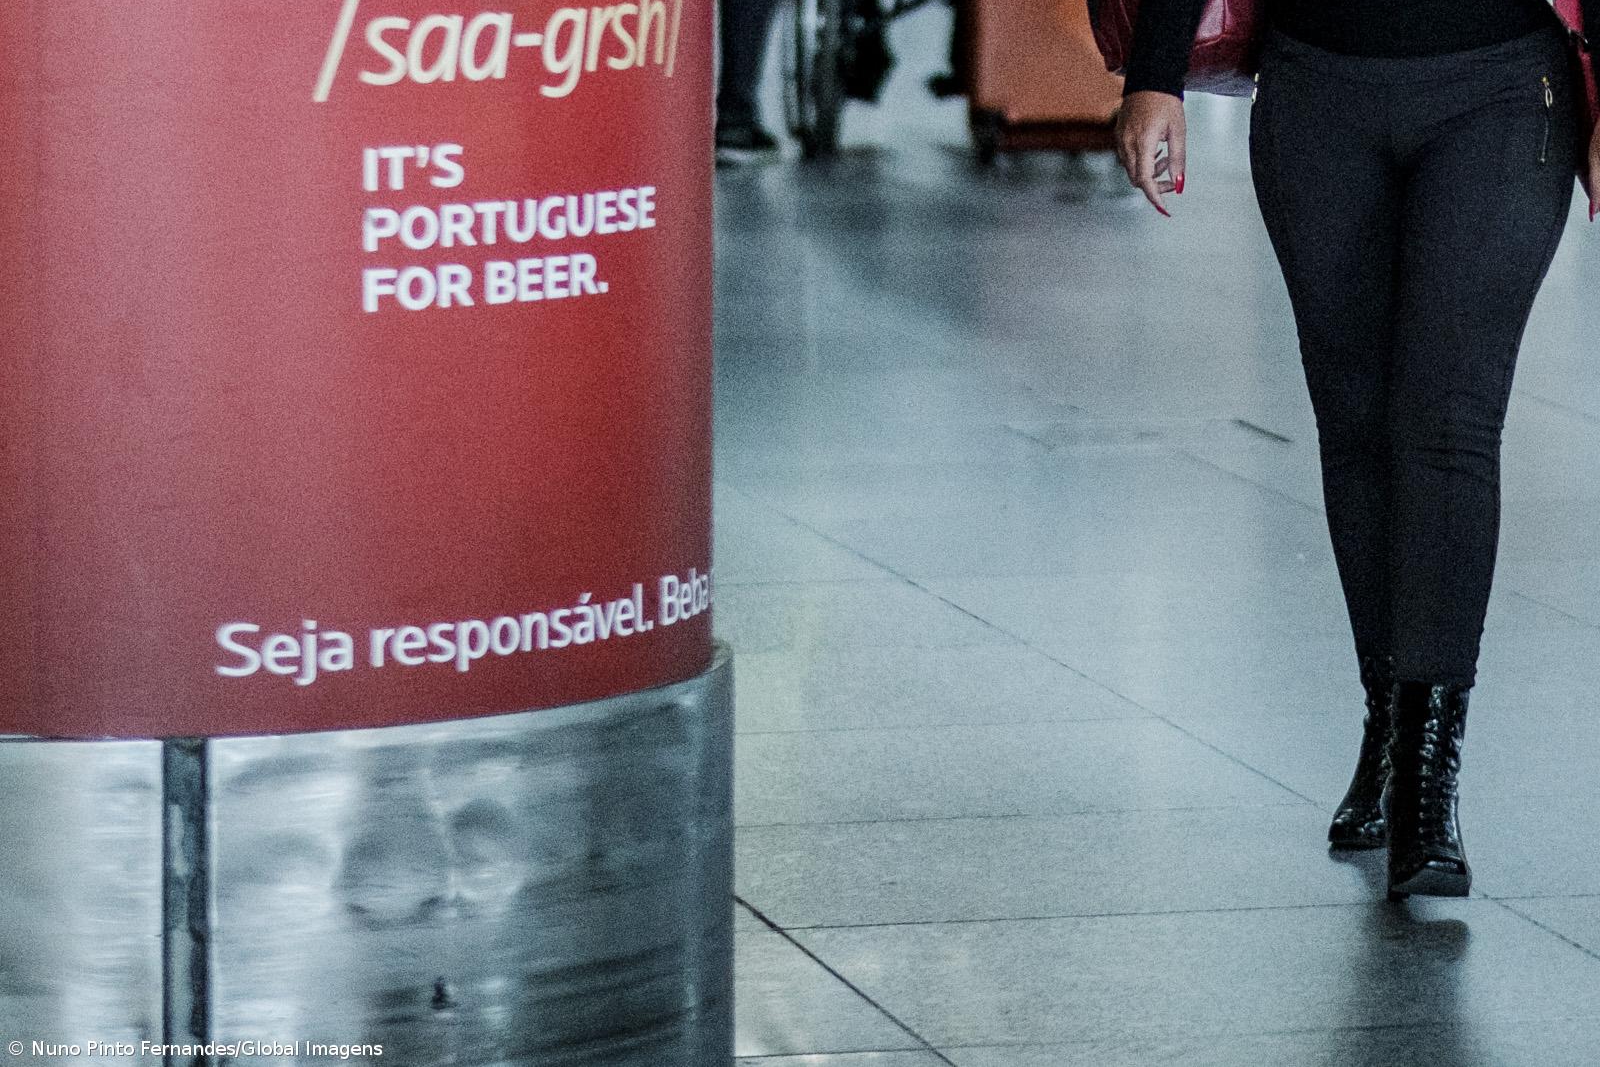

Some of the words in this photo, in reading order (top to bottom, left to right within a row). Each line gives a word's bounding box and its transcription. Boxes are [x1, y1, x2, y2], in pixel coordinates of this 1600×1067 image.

[362, 142, 465, 192] IT'S
[362, 186, 657, 253] PORTUGUESE
[362, 262, 475, 313] FOR
[484, 253, 609, 308] BEER.
[216, 618, 354, 686] Seja
[369, 582, 655, 673] responsável.
